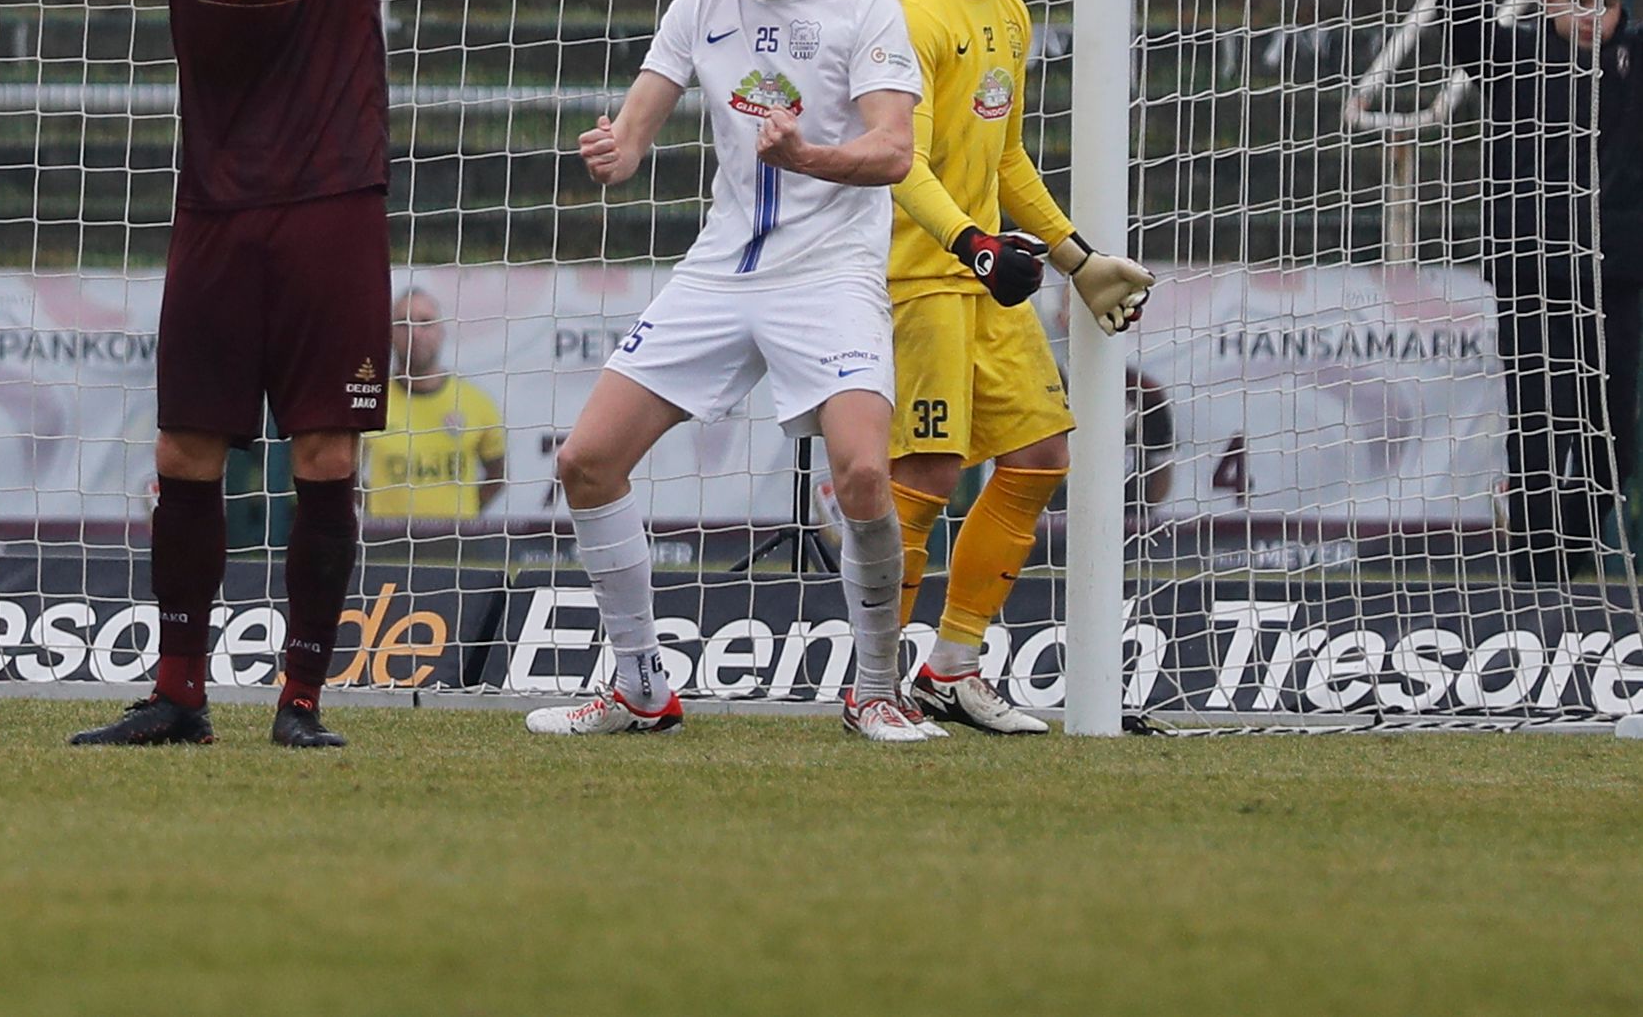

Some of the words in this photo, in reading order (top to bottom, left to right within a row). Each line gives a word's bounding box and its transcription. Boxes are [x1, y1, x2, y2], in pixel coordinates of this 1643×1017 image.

[755, 27, 780, 53] 25
[351, 397, 377, 409] JAKO
[912, 399, 949, 439] 32
[1211, 431, 1255, 506] 4
[159, 612, 189, 624] AKO
